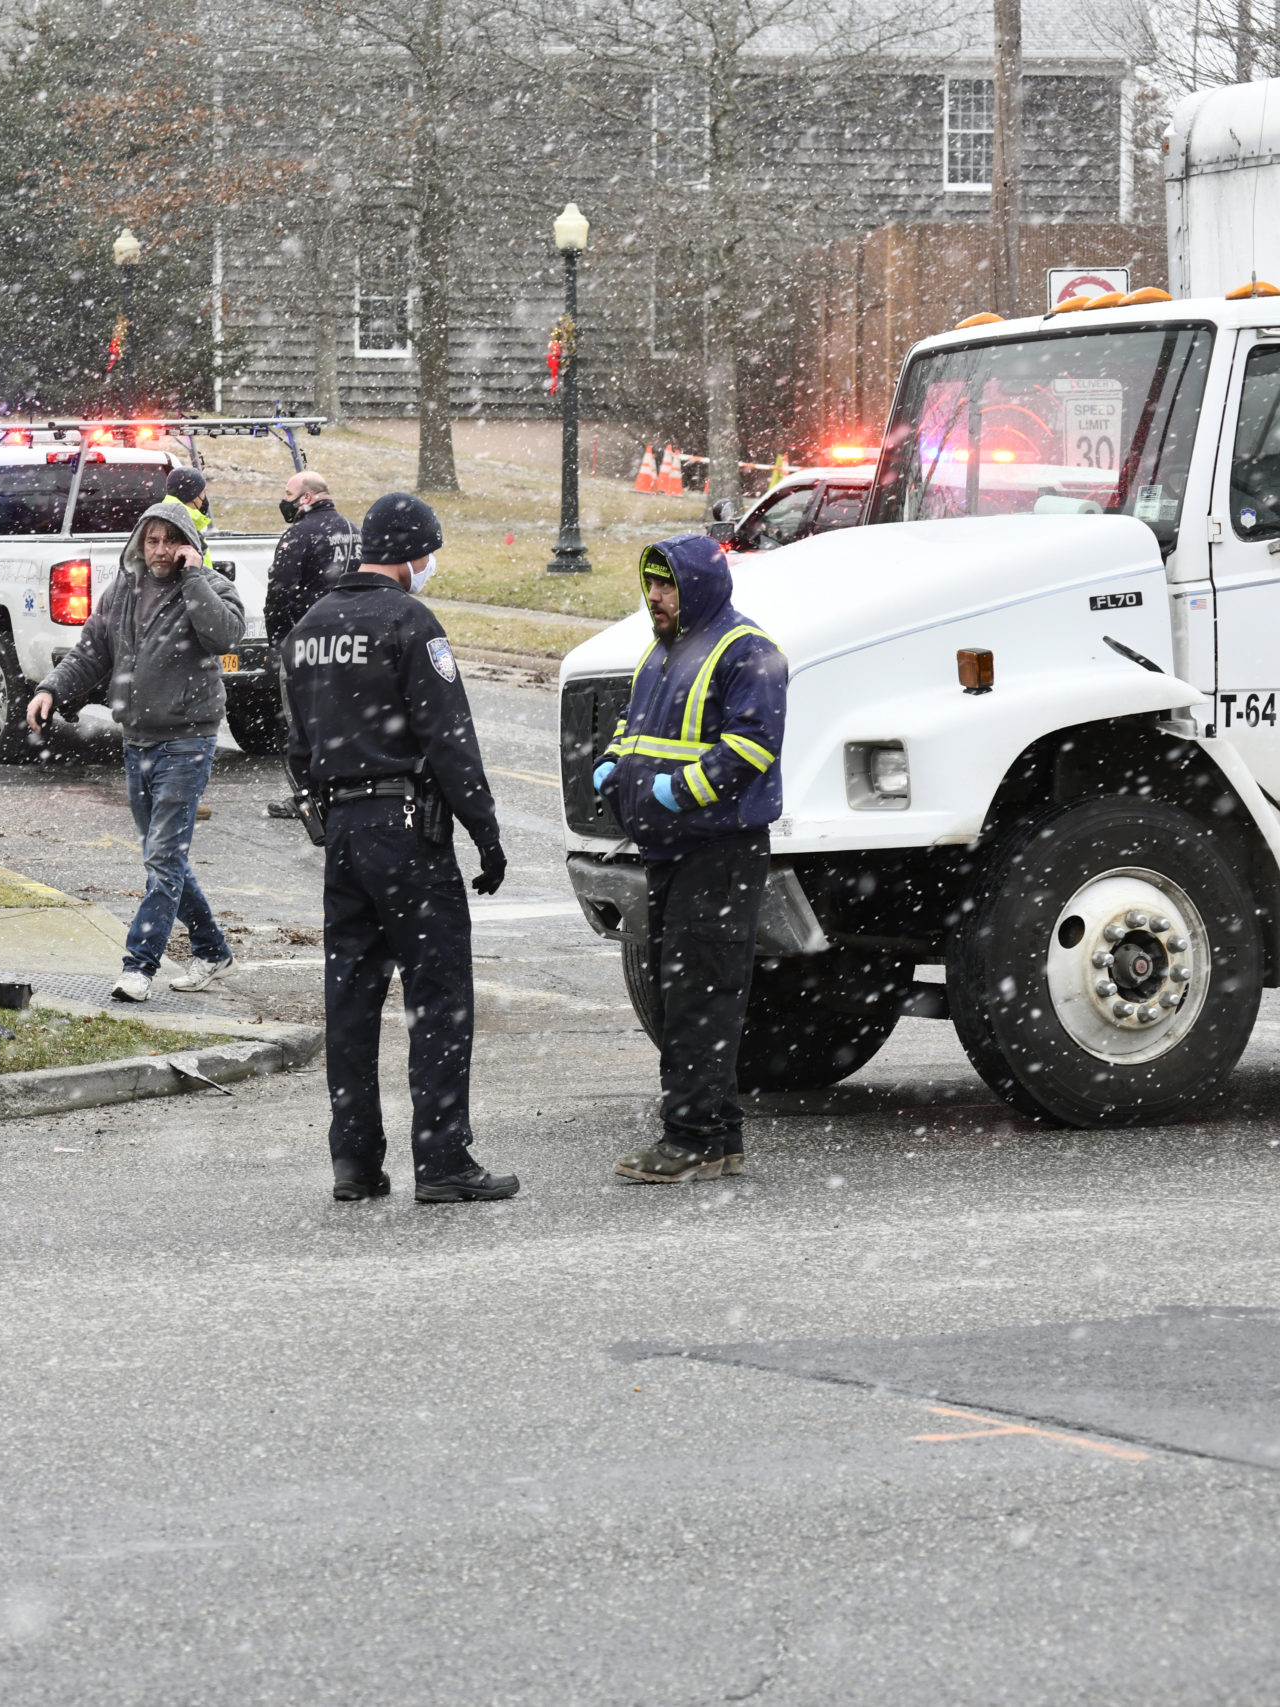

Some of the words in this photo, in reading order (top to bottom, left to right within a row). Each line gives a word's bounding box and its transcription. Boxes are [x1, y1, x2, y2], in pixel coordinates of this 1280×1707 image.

[1074, 404, 1116, 416] SPEED
[1078, 419, 1110, 431] LIMIT
[1076, 435, 1115, 471] 30
[1096, 593, 1137, 609] FL70
[295, 634, 368, 668] POLICE
[1220, 692, 1277, 728] T-64
